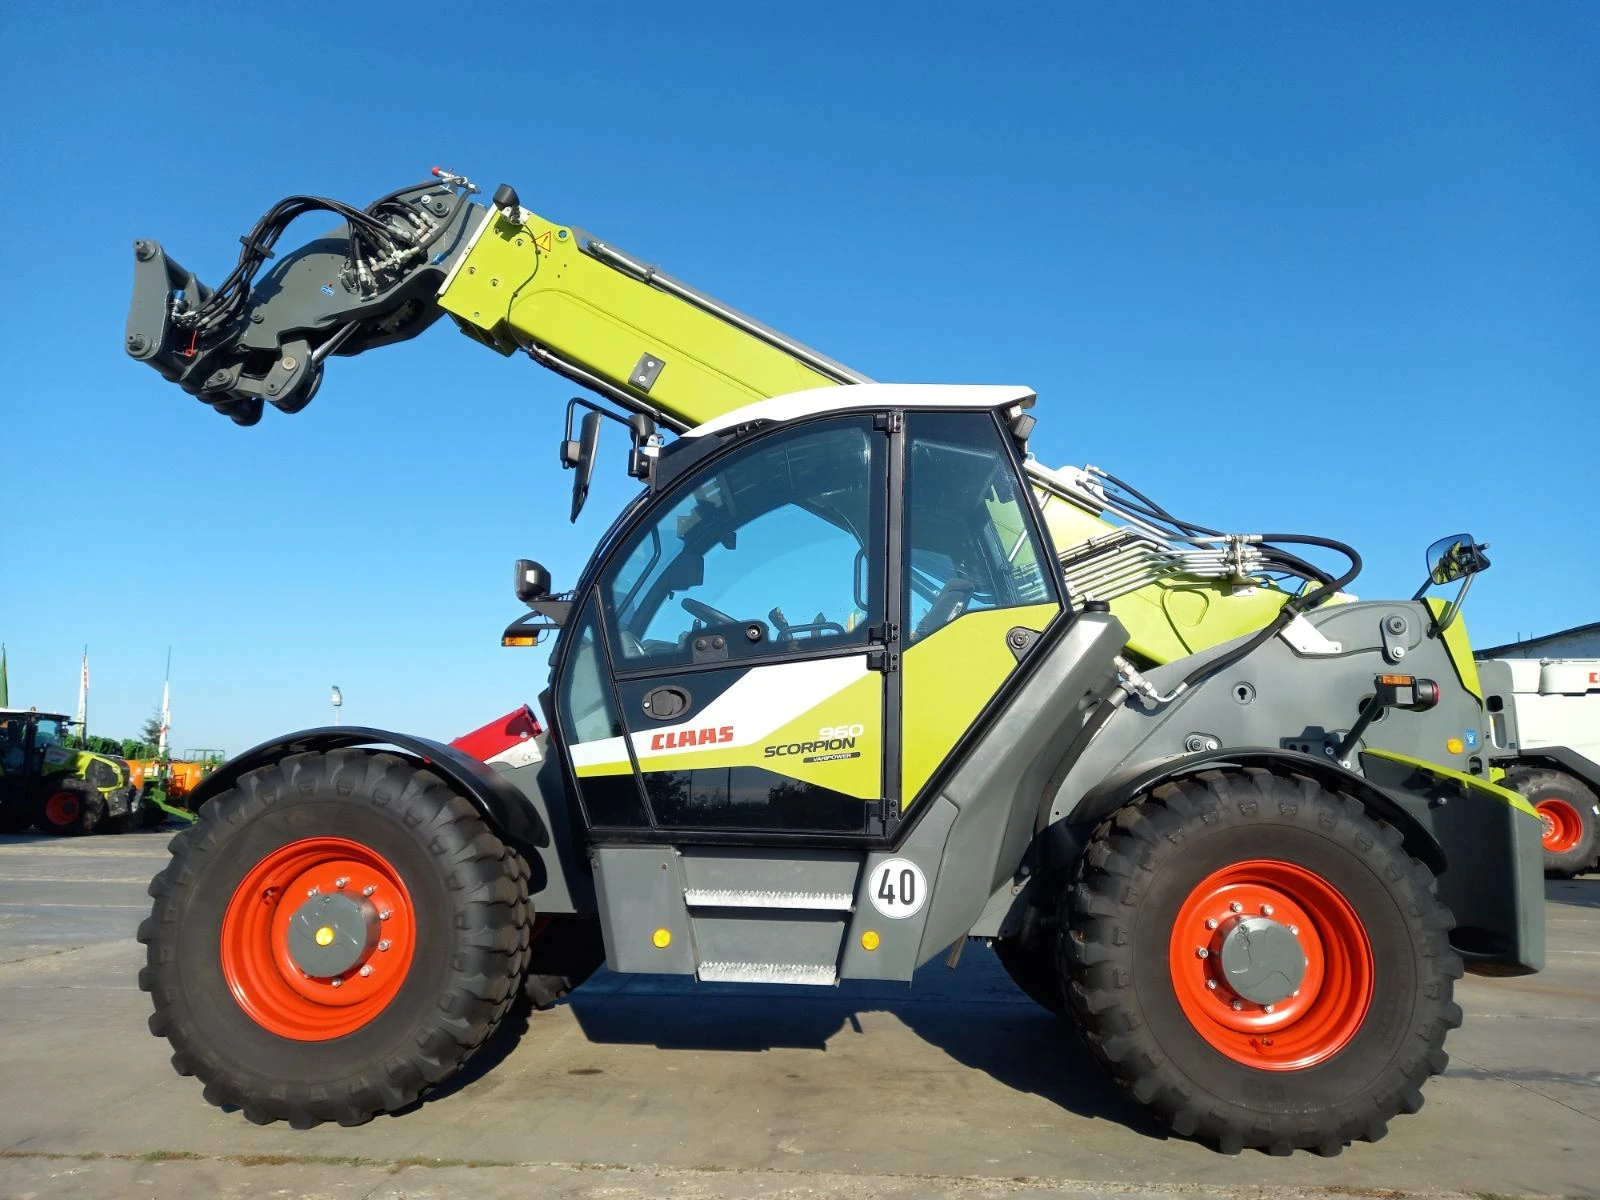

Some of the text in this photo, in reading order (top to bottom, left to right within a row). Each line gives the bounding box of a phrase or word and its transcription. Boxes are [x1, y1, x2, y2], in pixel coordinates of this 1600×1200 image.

[651, 726, 734, 750] CLAAS
[819, 724, 864, 741] 960
[764, 737, 856, 757] SCORPION
[878, 869, 915, 905] 40
